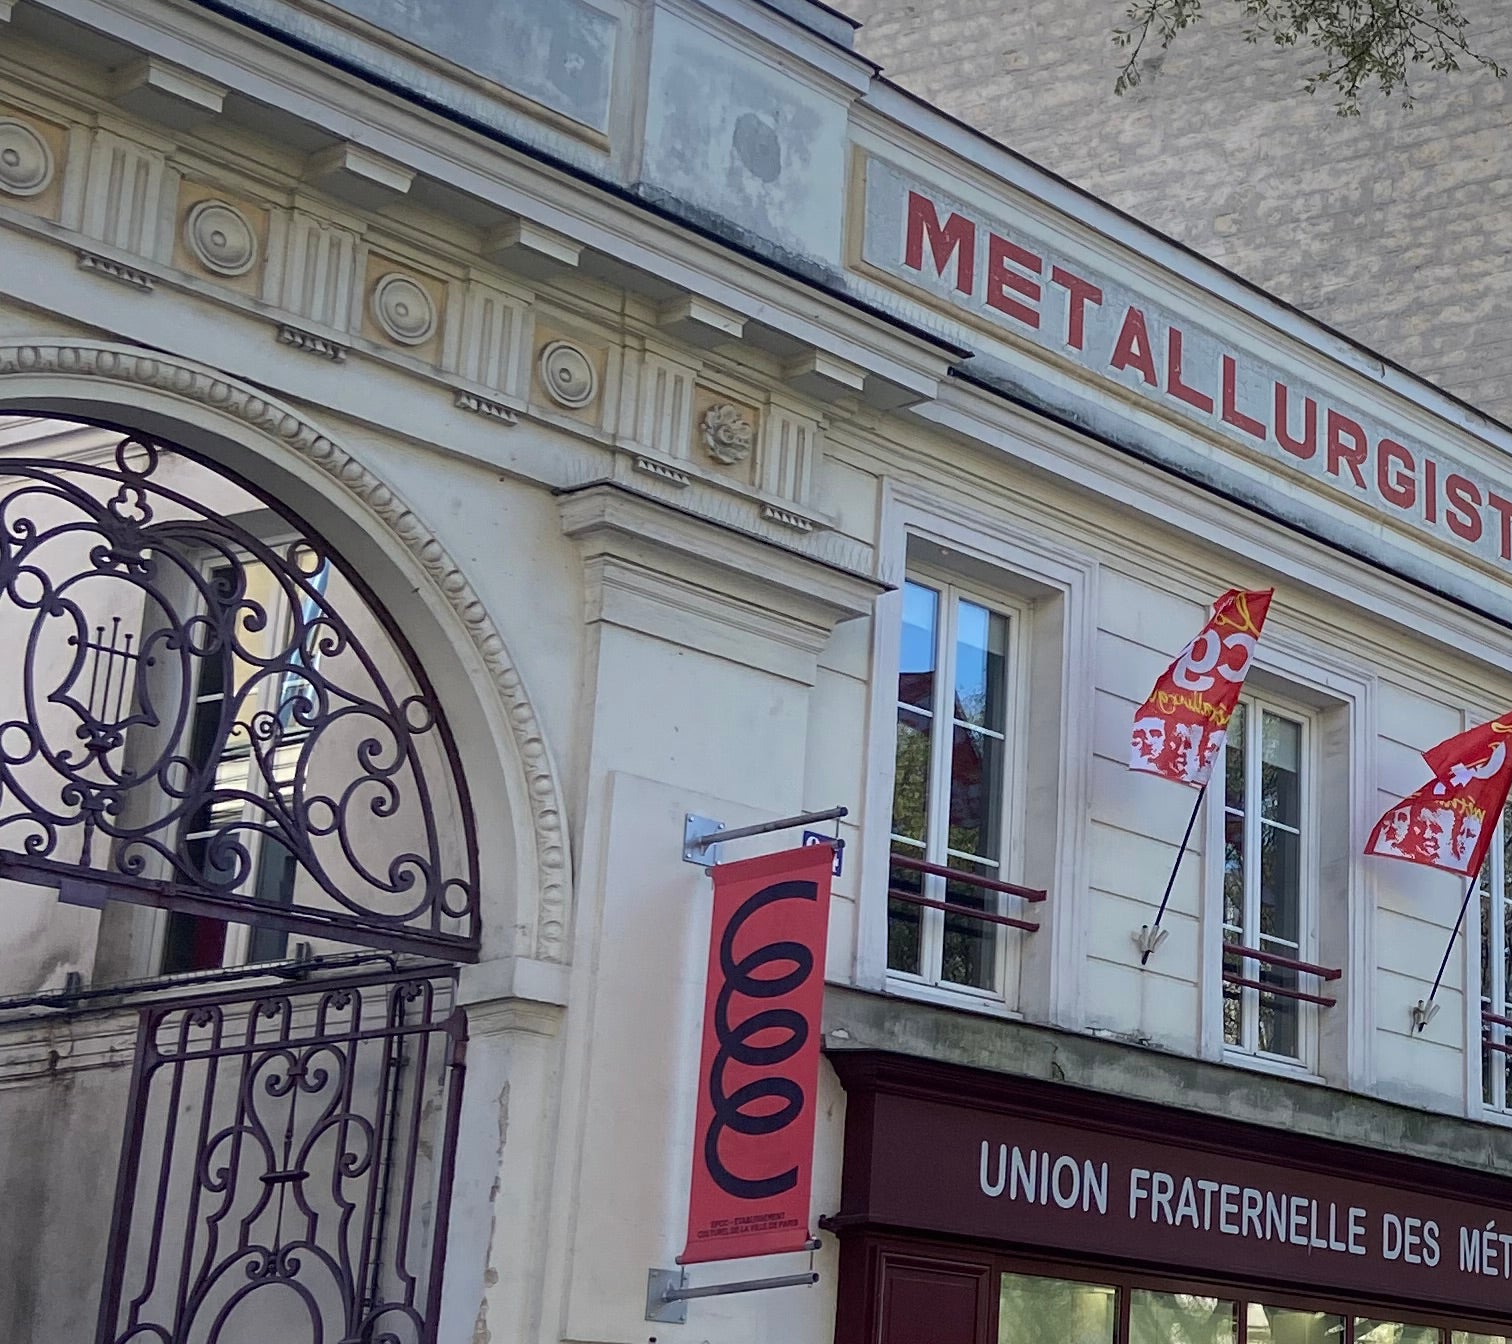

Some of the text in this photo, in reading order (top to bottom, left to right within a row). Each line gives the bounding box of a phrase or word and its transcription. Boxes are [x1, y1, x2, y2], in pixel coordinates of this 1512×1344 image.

[979, 1139, 1110, 1215] UNION
[1129, 1168, 1368, 1257] FRATERNELLE
[1382, 1212, 1441, 1269] DES
